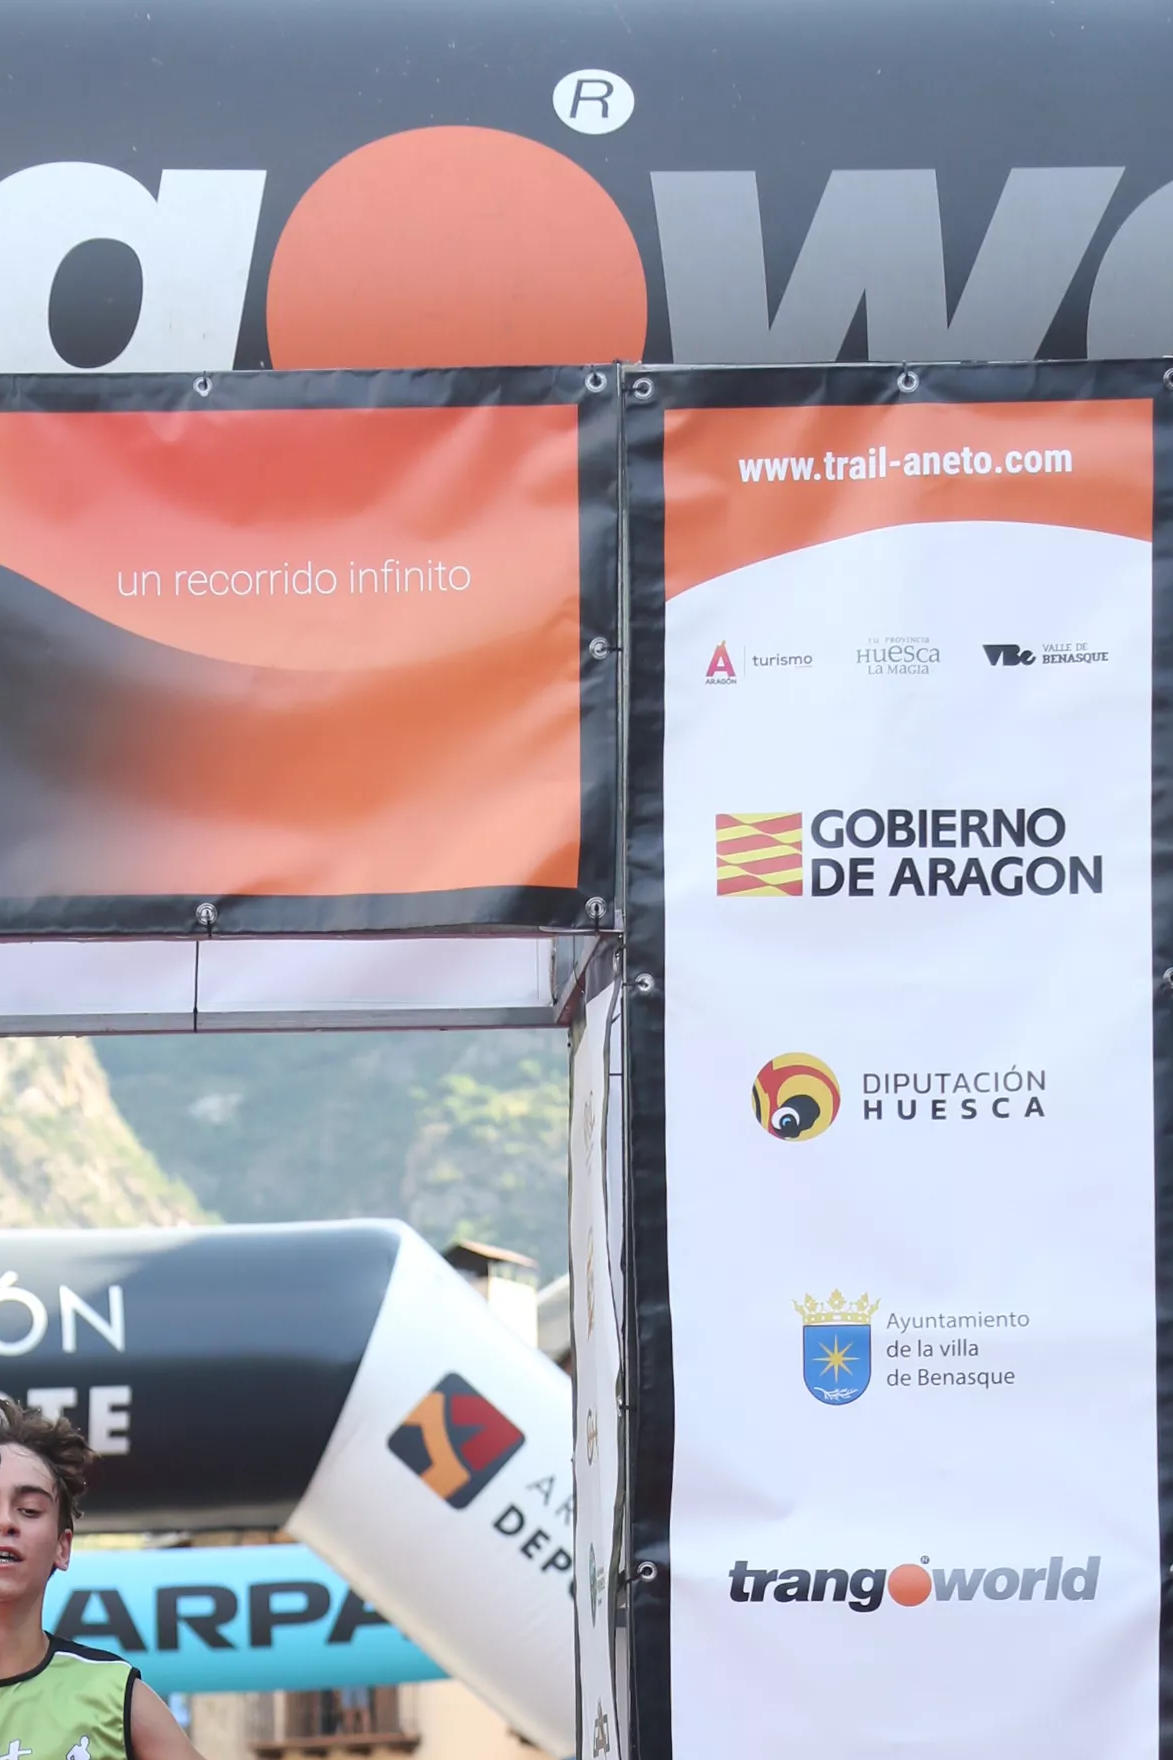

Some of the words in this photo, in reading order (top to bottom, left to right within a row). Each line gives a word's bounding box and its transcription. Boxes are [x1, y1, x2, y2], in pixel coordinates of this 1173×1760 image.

[738, 446, 1073, 482] www.trail-aneto.com
[117, 569, 161, 596] un
[175, 561, 337, 596] recorrido
[349, 558, 471, 593] infinito
[752, 653, 813, 667] turismo
[1041, 651, 1109, 664] BENASQUE
[1042, 643, 1072, 653] VALLE
[1075, 642, 1088, 651] DE
[811, 807, 1066, 849] GOBIERNO
[811, 857, 874, 897] DE
[889, 855, 1103, 897] ARAGON
[863, 1064, 1046, 1095] DIPUTACIÓN
[863, 1096, 1046, 1121] HUESCA
[886, 1312, 1030, 1334] Ayuntamiento
[886, 1340, 911, 1358] de
[917, 1340, 933, 1357] la
[940, 1339, 979, 1357] villa
[886, 1369, 911, 1387] de
[918, 1368, 1016, 1388] Benasque
[728, 1556, 1101, 1612] trangoworld
